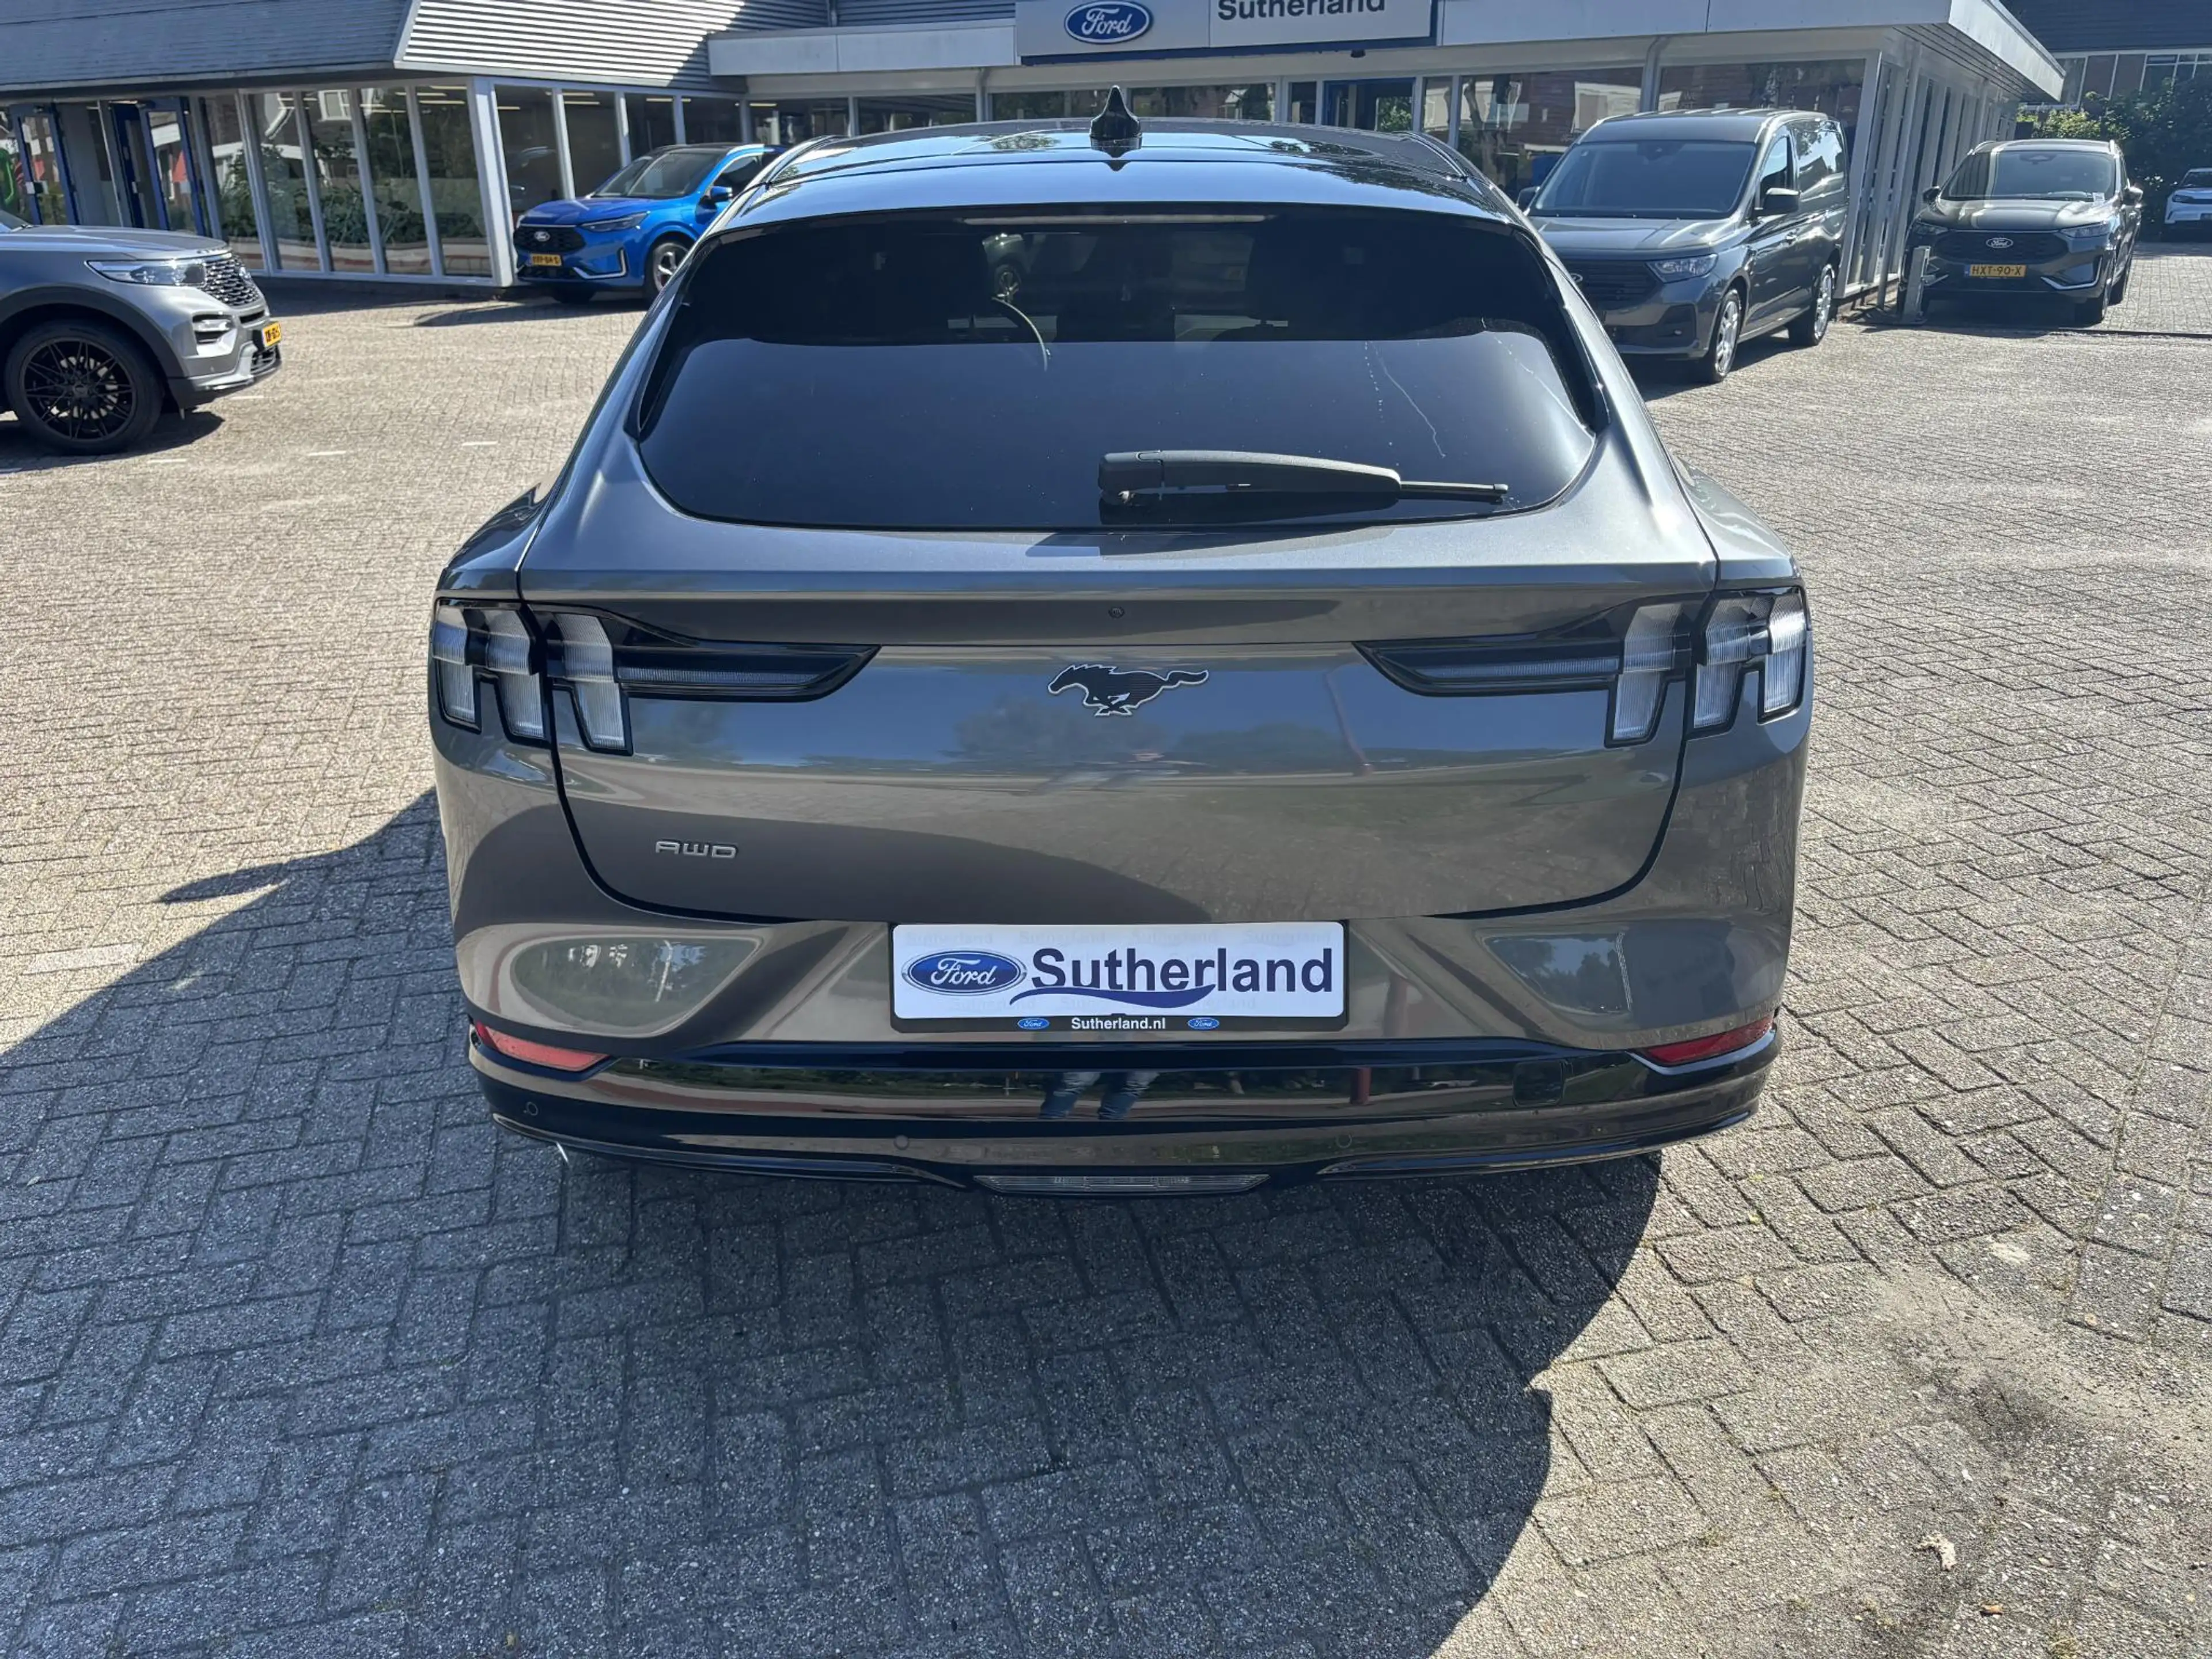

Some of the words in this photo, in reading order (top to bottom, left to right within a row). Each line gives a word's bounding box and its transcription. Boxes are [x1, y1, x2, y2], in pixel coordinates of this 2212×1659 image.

[1081, 7, 1132, 35] Ford
[1972, 266, 2022, 275] HXT-90-X
[656, 840, 737, 858] AWD
[930, 957, 997, 985] Ford
[1031, 948, 1332, 993] Sutherland
[1071, 1017, 1166, 1029] Sutherland.nl
